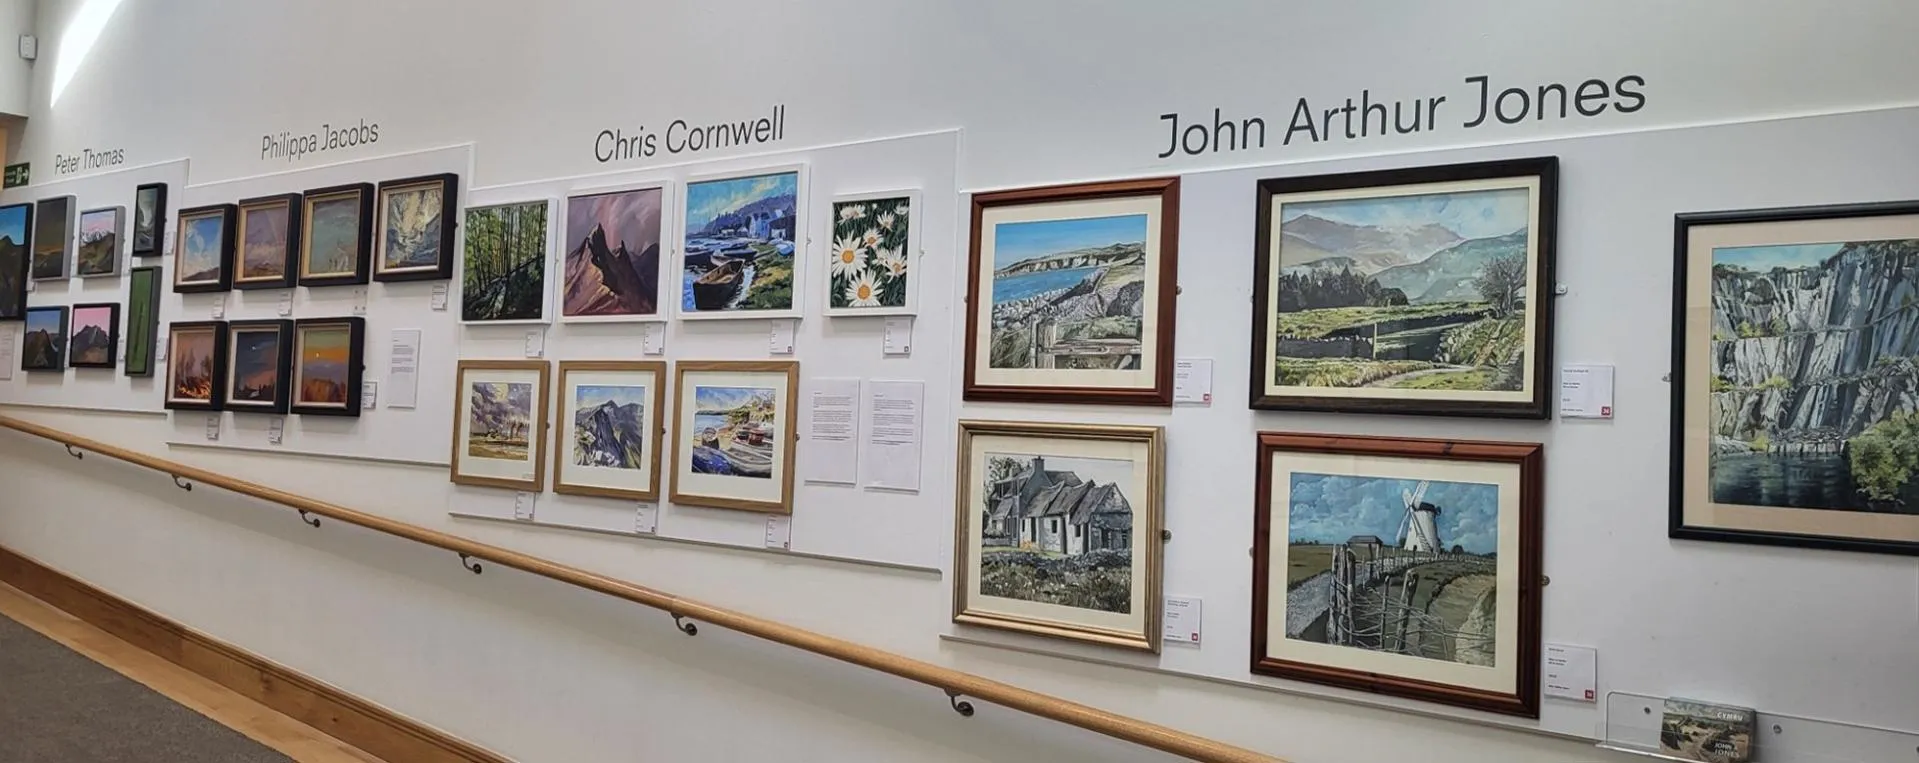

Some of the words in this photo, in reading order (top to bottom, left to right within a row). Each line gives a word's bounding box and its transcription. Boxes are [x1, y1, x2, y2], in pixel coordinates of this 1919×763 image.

[261, 131, 317, 162] Philippa
[321, 118, 379, 151] Jacobs
[595, 125, 657, 162] Chris
[666, 104, 785, 153] Cornwell
[1158, 108, 1265, 159] John
[1283, 90, 1446, 146] Arthur
[1463, 75, 1647, 128] Jones
[55, 154, 80, 175] Peter
[83, 148, 125, 169] Thomas
